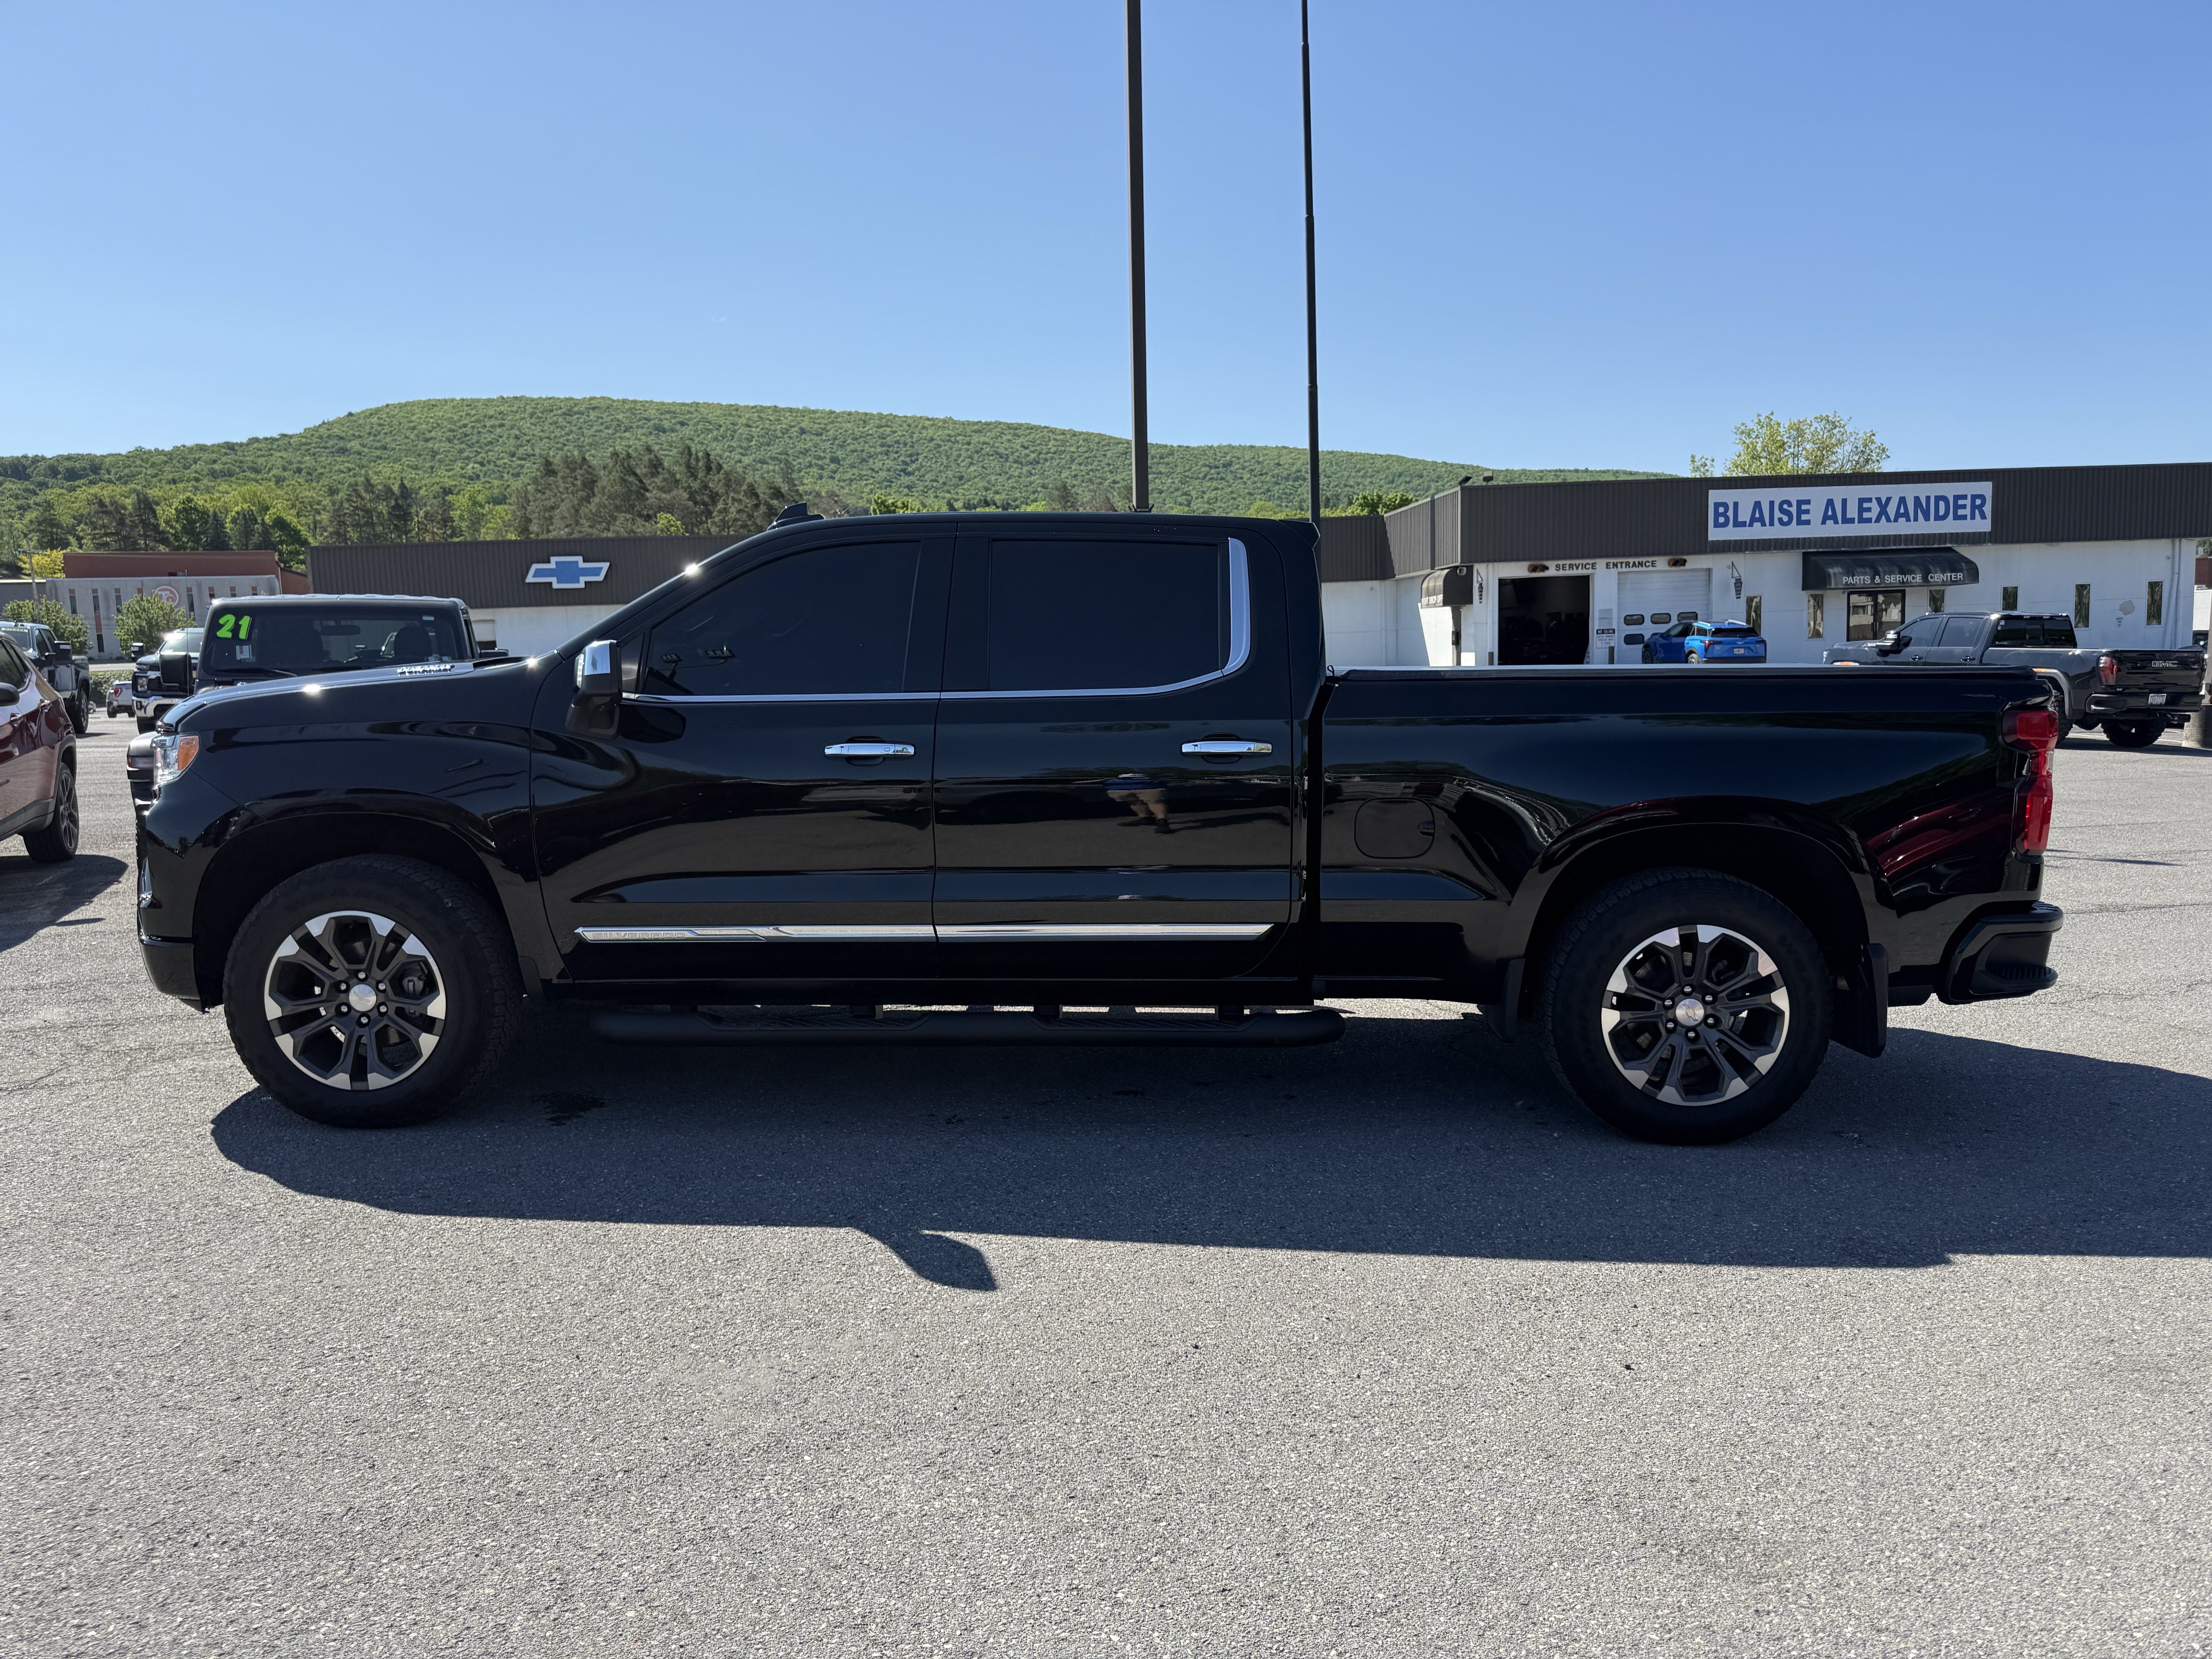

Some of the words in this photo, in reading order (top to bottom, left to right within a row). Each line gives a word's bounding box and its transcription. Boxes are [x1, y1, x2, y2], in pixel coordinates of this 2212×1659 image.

[1713, 499, 1812, 528] BLAISE
[1820, 494, 1987, 525] ALEXANDER
[1555, 562, 1597, 571] SERVICE
[1606, 560, 1657, 569] ENTRANCE
[1843, 576, 1870, 584] PARTS
[1885, 574, 1922, 583] SERVICE
[1928, 573, 1963, 581] CENTER
[216, 614, 252, 640] 21
